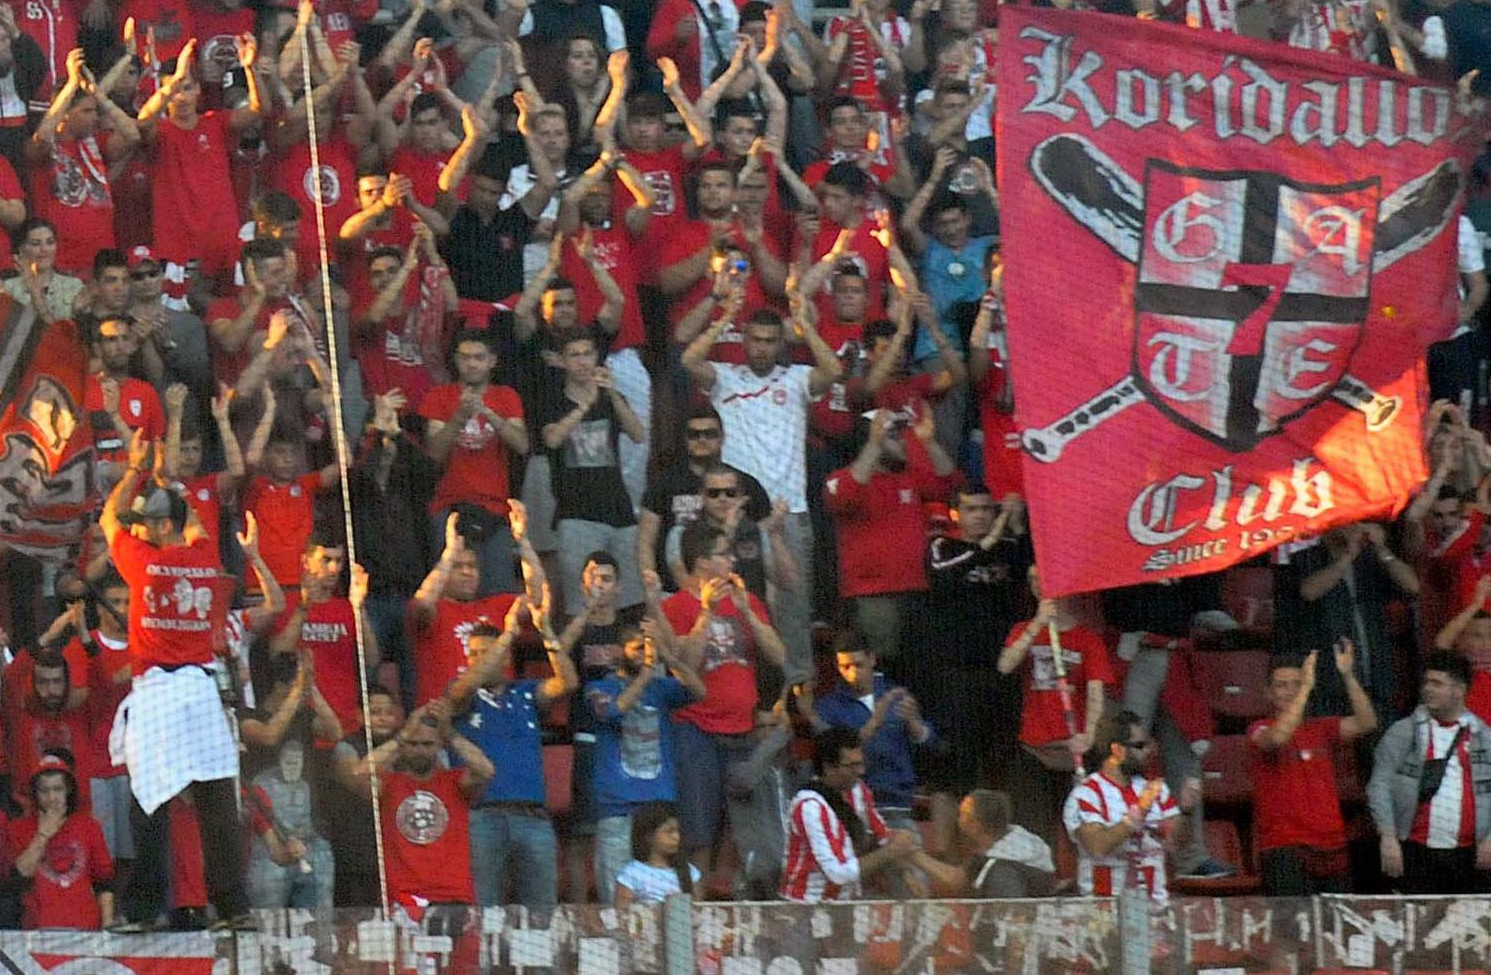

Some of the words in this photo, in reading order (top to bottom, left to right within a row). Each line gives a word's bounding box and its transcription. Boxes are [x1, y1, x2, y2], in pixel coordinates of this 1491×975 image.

[1219, 261, 1294, 357] 7
[1127, 456, 1336, 546] Club
[1142, 536, 1229, 571] Since
